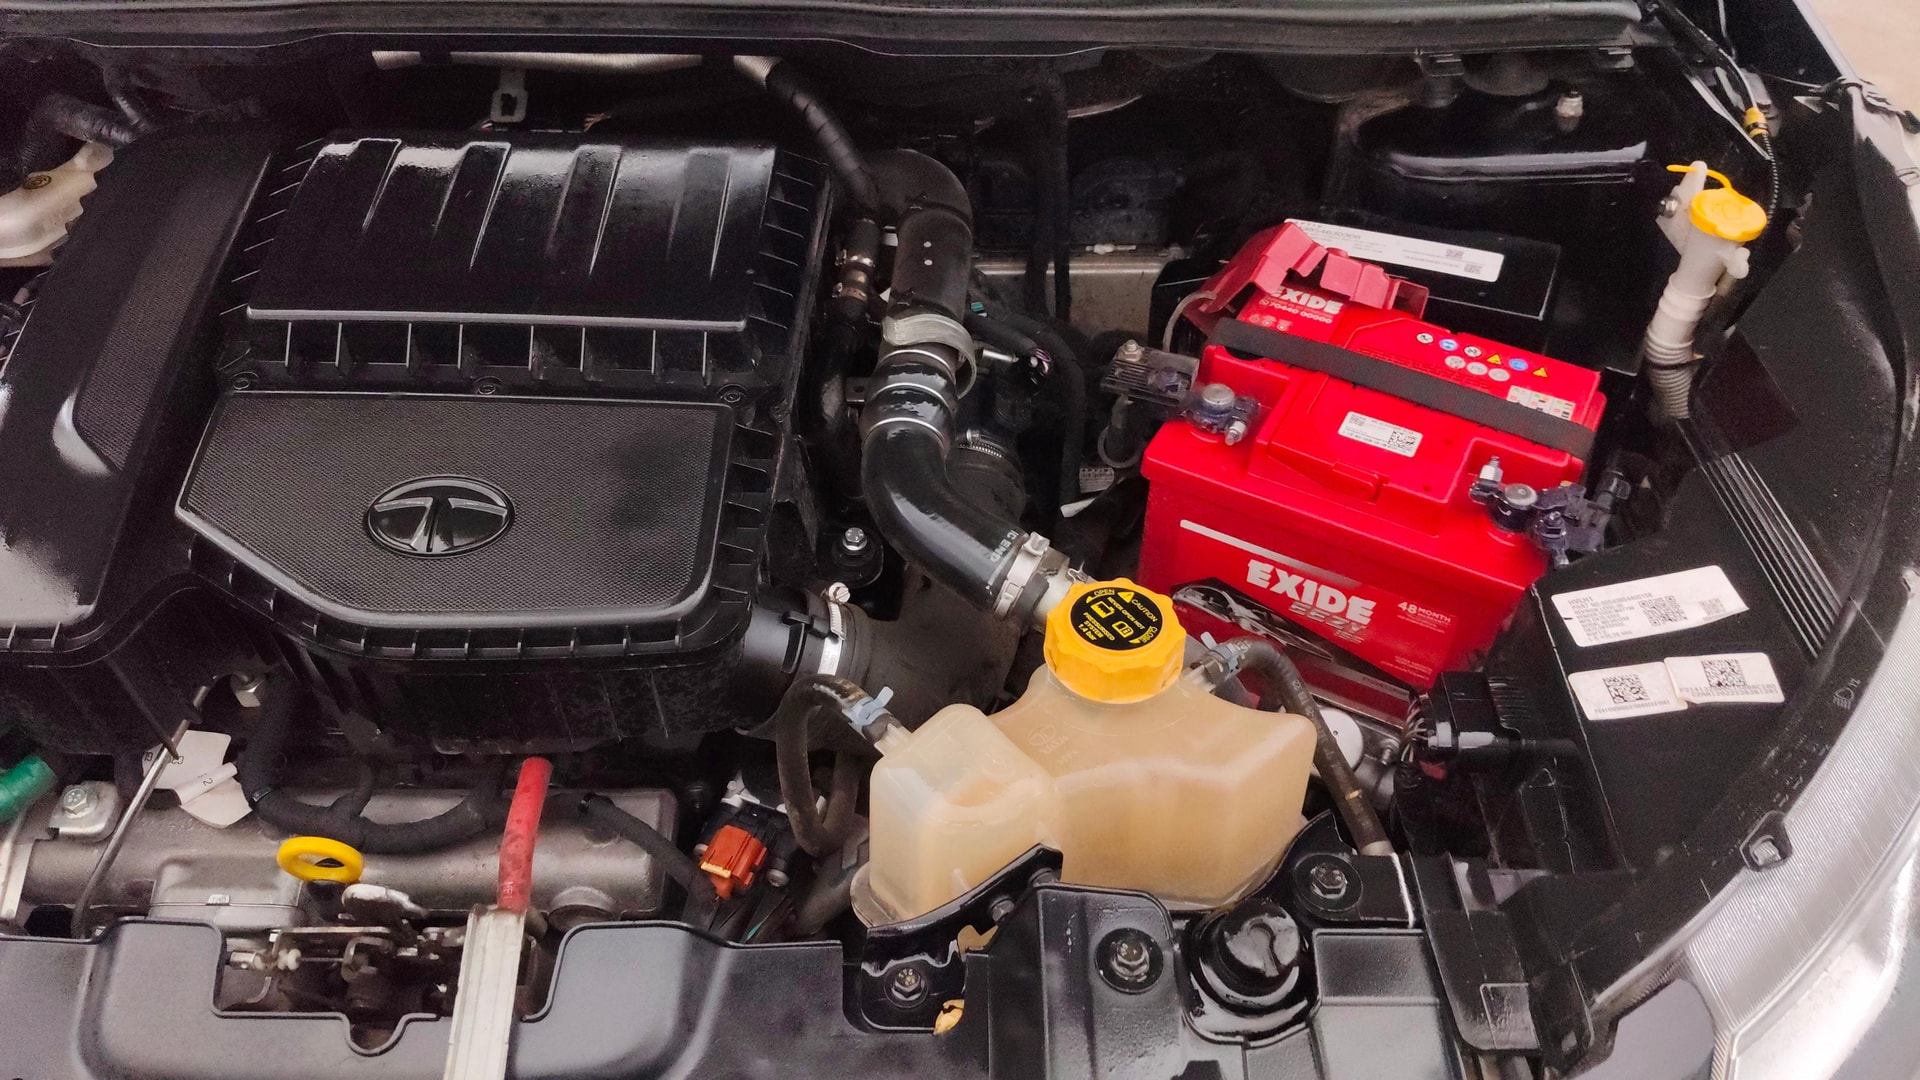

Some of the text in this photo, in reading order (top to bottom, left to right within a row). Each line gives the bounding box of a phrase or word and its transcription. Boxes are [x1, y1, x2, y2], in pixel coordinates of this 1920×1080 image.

[1300, 311, 1333, 324] 00000
[1093, 588, 1116, 596] OPEN
[1246, 559, 1377, 625] EXIDE
[1121, 608, 1136, 622] OPEN
[1133, 619, 1146, 630] HOT
[1131, 599, 1158, 623] CAUTION
[1288, 600, 1369, 634] EEZY
[1397, 601, 1451, 623] 48 MONTH
[1085, 631, 1098, 641] bar
